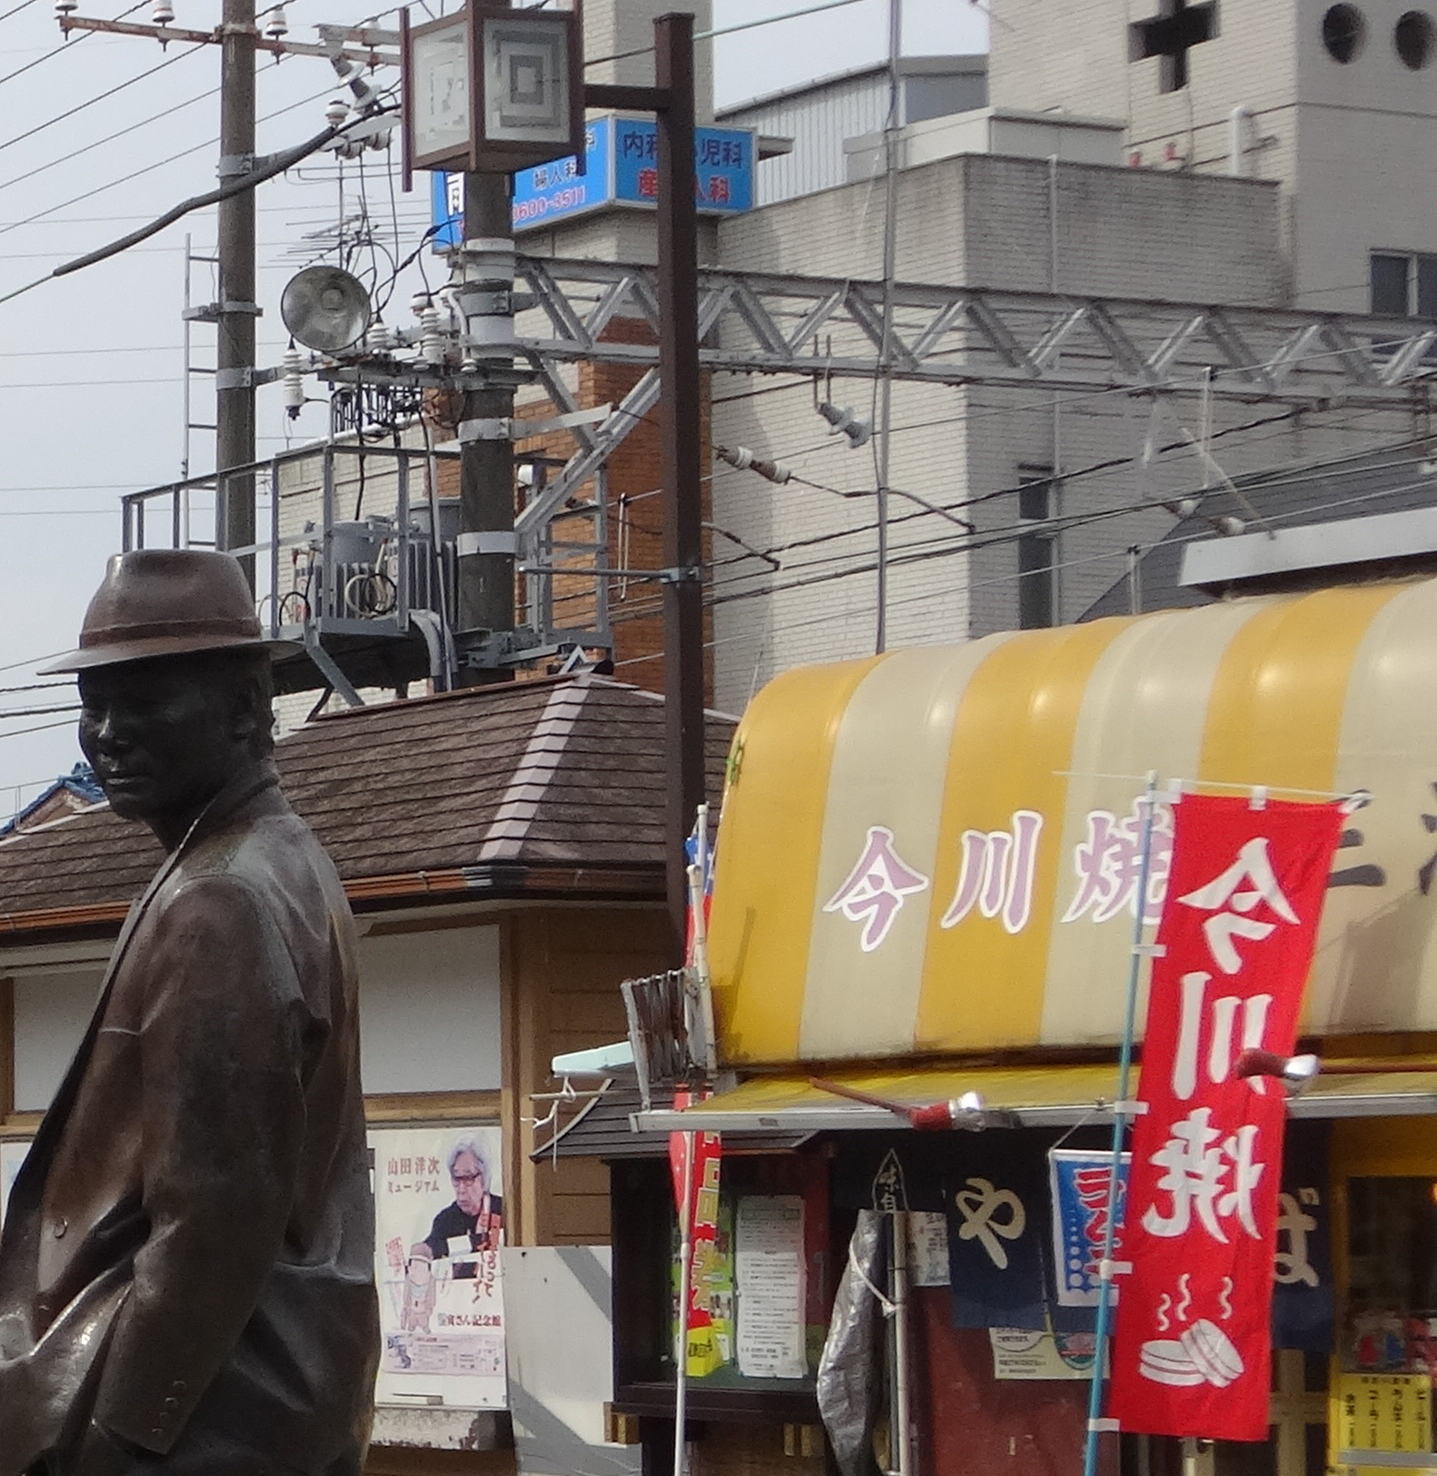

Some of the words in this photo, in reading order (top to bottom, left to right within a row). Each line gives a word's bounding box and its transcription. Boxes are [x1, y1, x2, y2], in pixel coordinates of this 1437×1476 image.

[701, 138, 743, 168] 児科
[823, 794, 1175, 954] 今川焼
[387, 1156, 440, 1177] 山田洋次
[954, 1176, 1027, 1271] や
